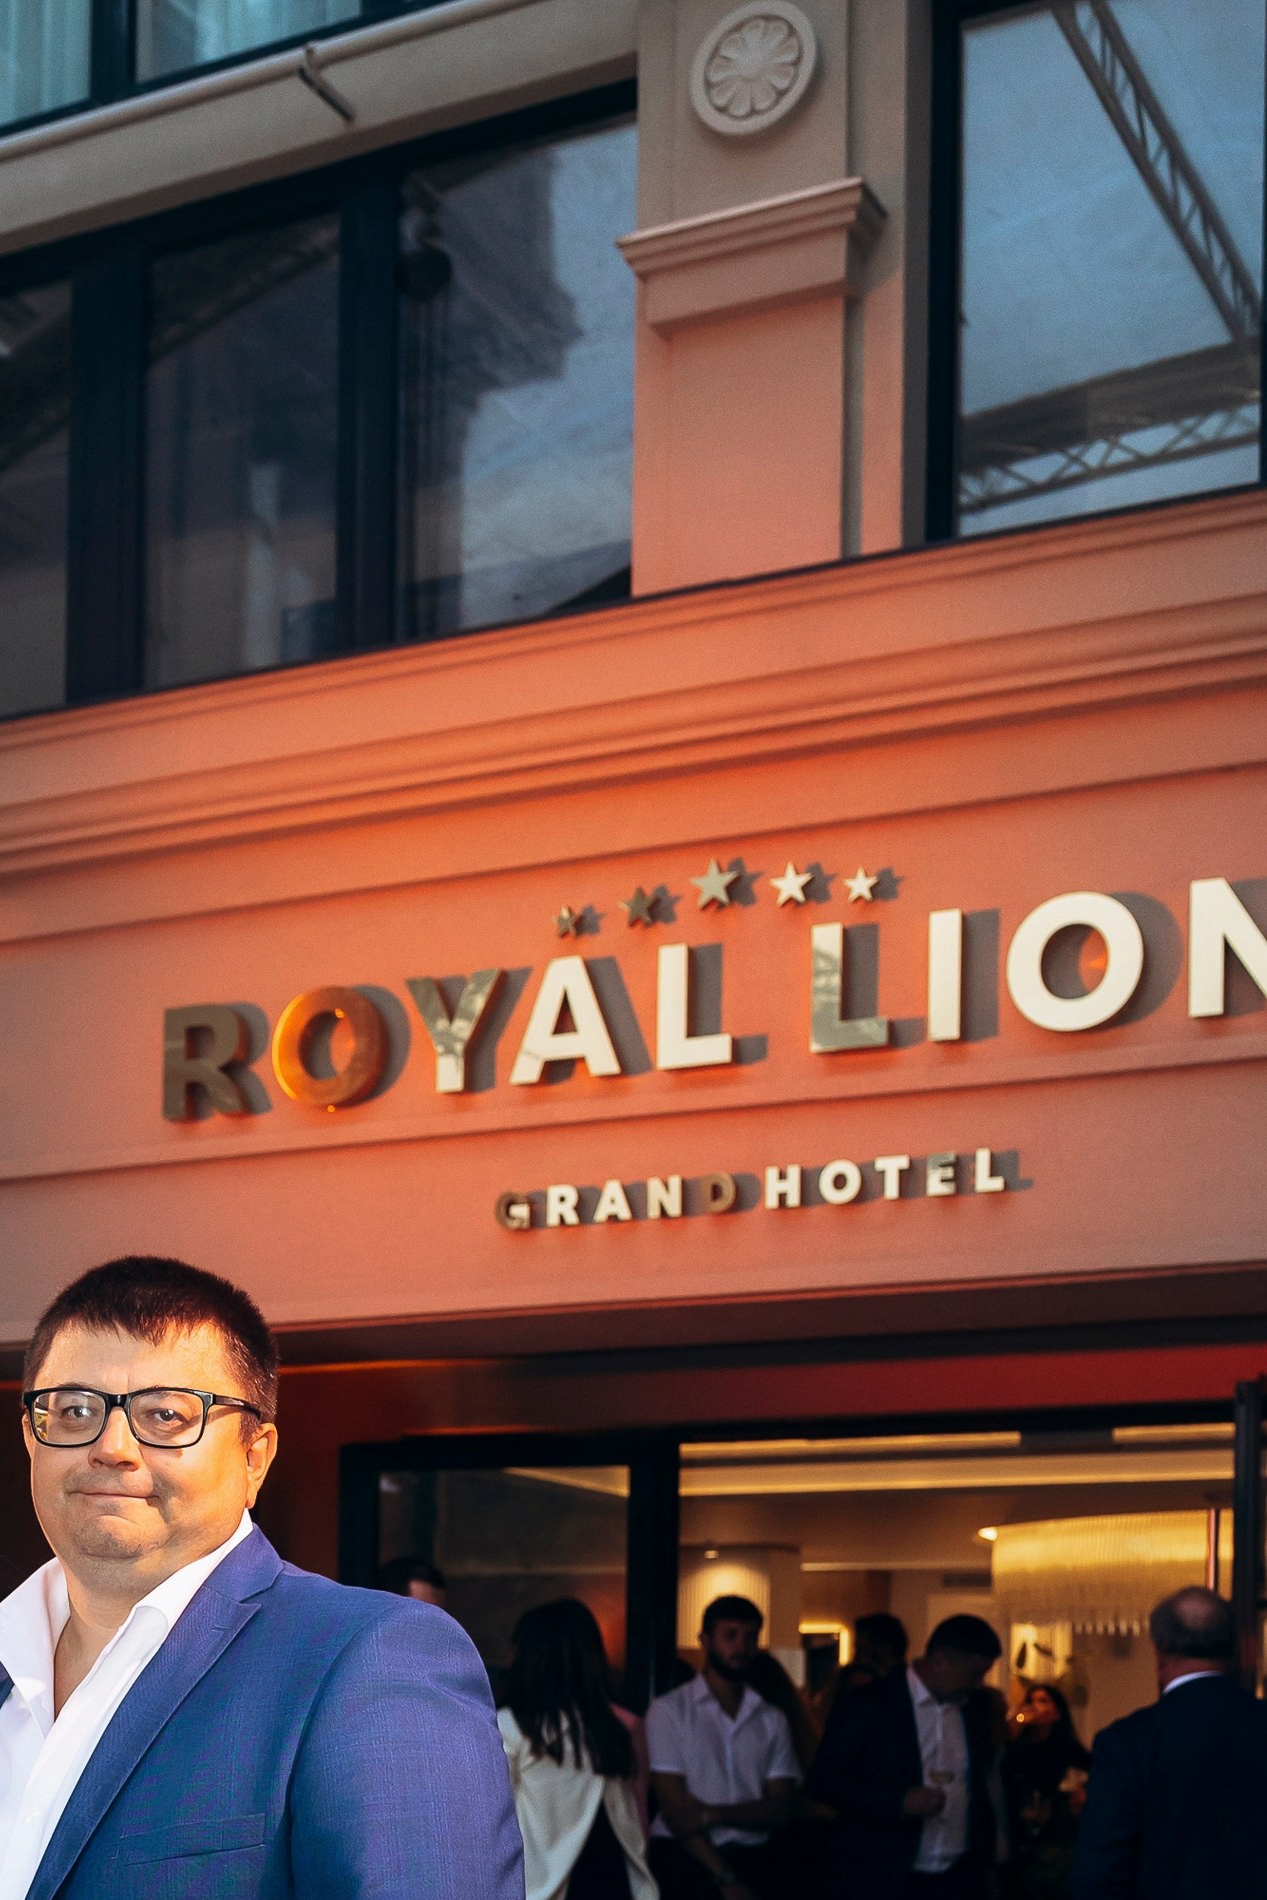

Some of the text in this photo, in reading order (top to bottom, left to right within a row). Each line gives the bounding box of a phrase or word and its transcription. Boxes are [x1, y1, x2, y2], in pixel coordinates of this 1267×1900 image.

[160, 876, 1267, 1122] ROYAL LION
[495, 1147, 1005, 1231] GRAND HOTEL
